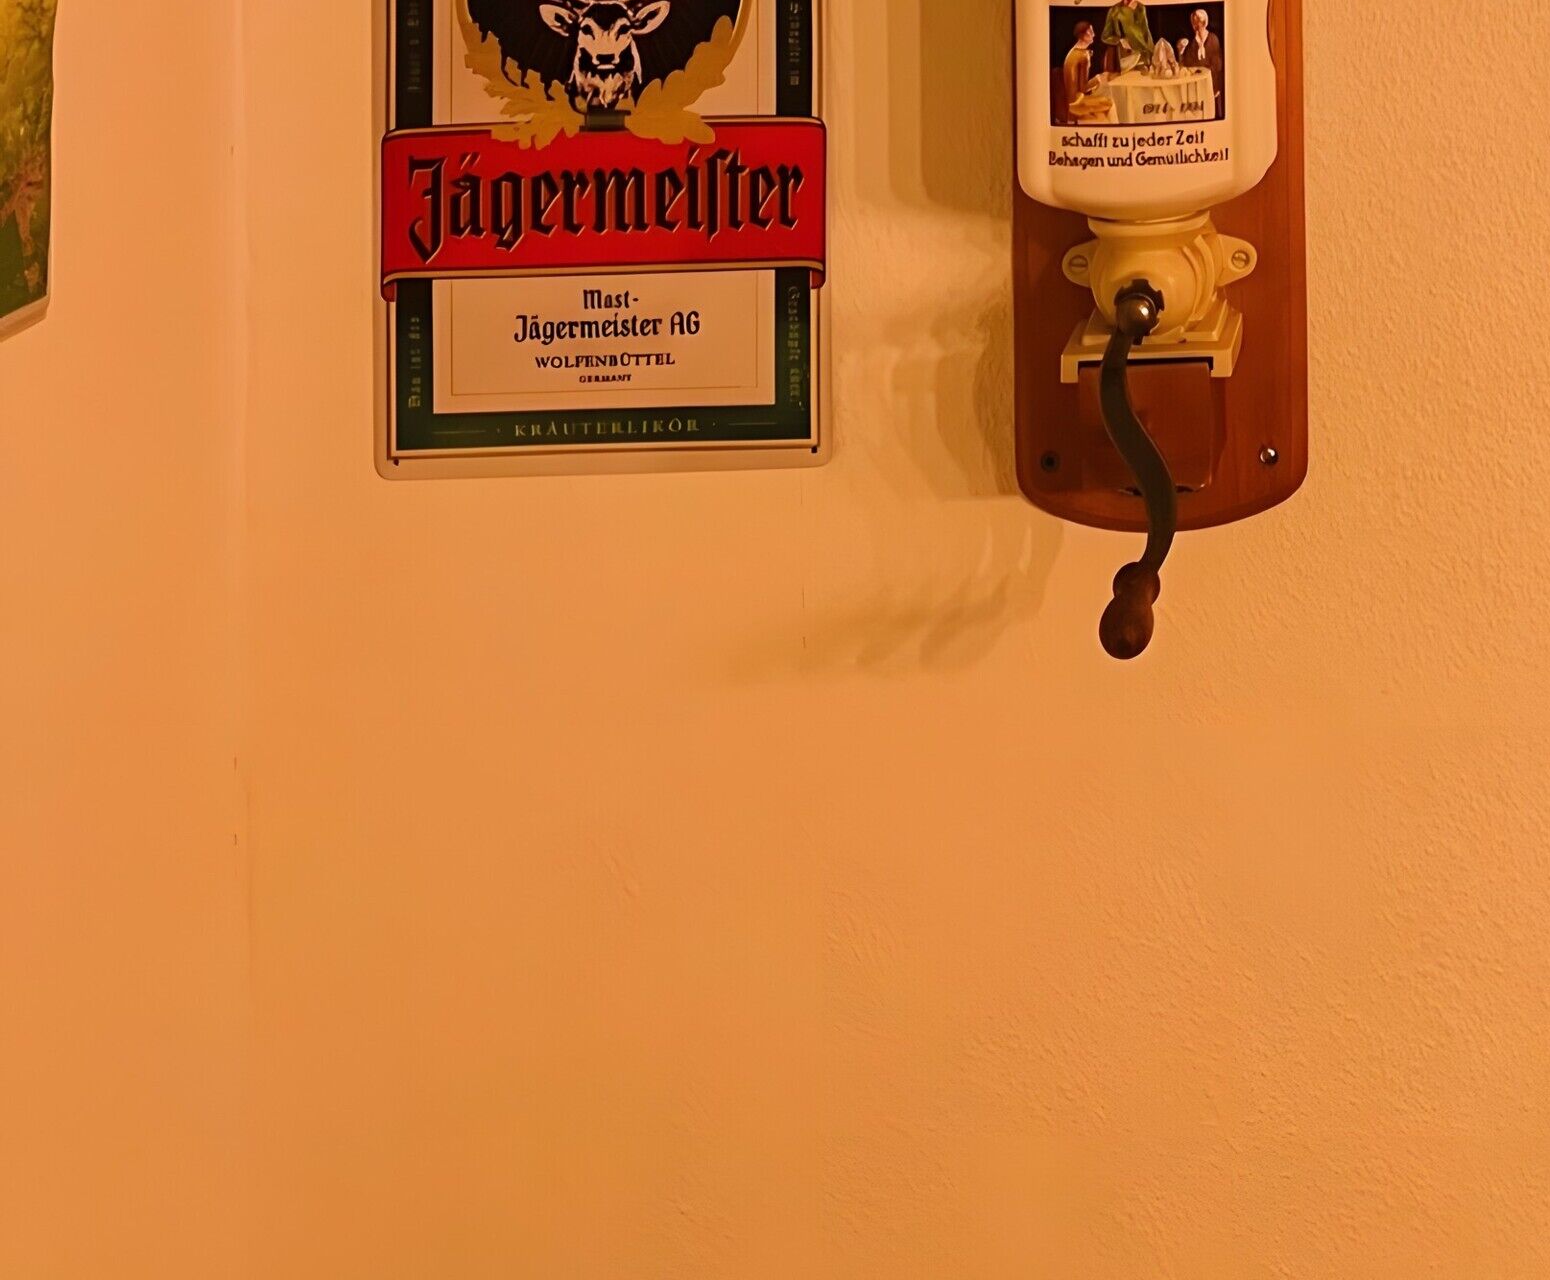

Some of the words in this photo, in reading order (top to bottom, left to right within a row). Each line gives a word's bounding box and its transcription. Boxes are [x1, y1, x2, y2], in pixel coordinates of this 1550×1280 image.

[1112, 134, 1129, 148] zu
[1132, 132, 1173, 151] jeder
[1176, 130, 1204, 146] Zeit
[1049, 151, 1104, 170] Behagen
[1107, 152, 1132, 167] und
[408, 146, 805, 264] Jägermeister
[583, 289, 639, 309] Mast-
[514, 312, 662, 345] Jägermeister
[670, 311, 700, 335] AG
